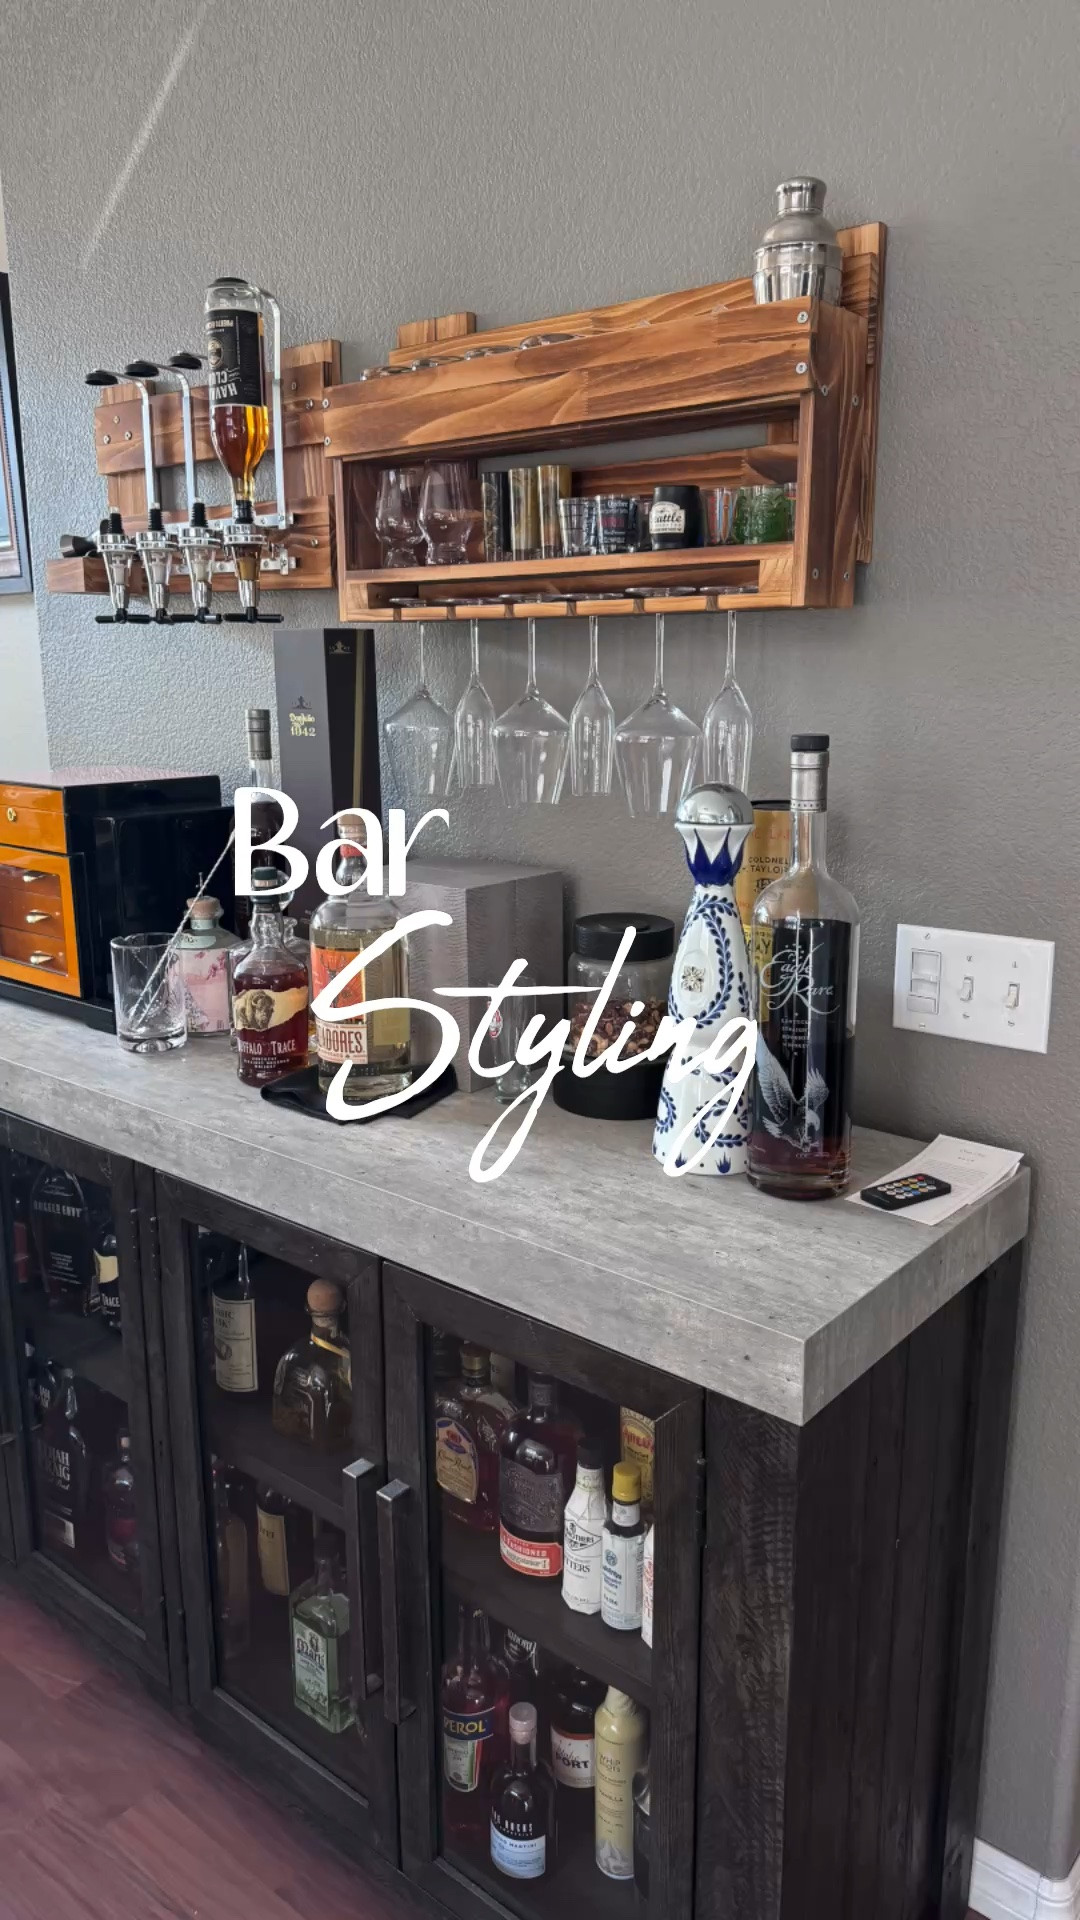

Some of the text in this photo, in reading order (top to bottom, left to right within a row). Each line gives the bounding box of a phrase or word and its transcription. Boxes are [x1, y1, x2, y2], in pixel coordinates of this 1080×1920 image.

[270, 1039, 297, 1056] TRACE
[565, 1557, 591, 1574] TTERS
[444, 1715, 487, 1736] PEROL
